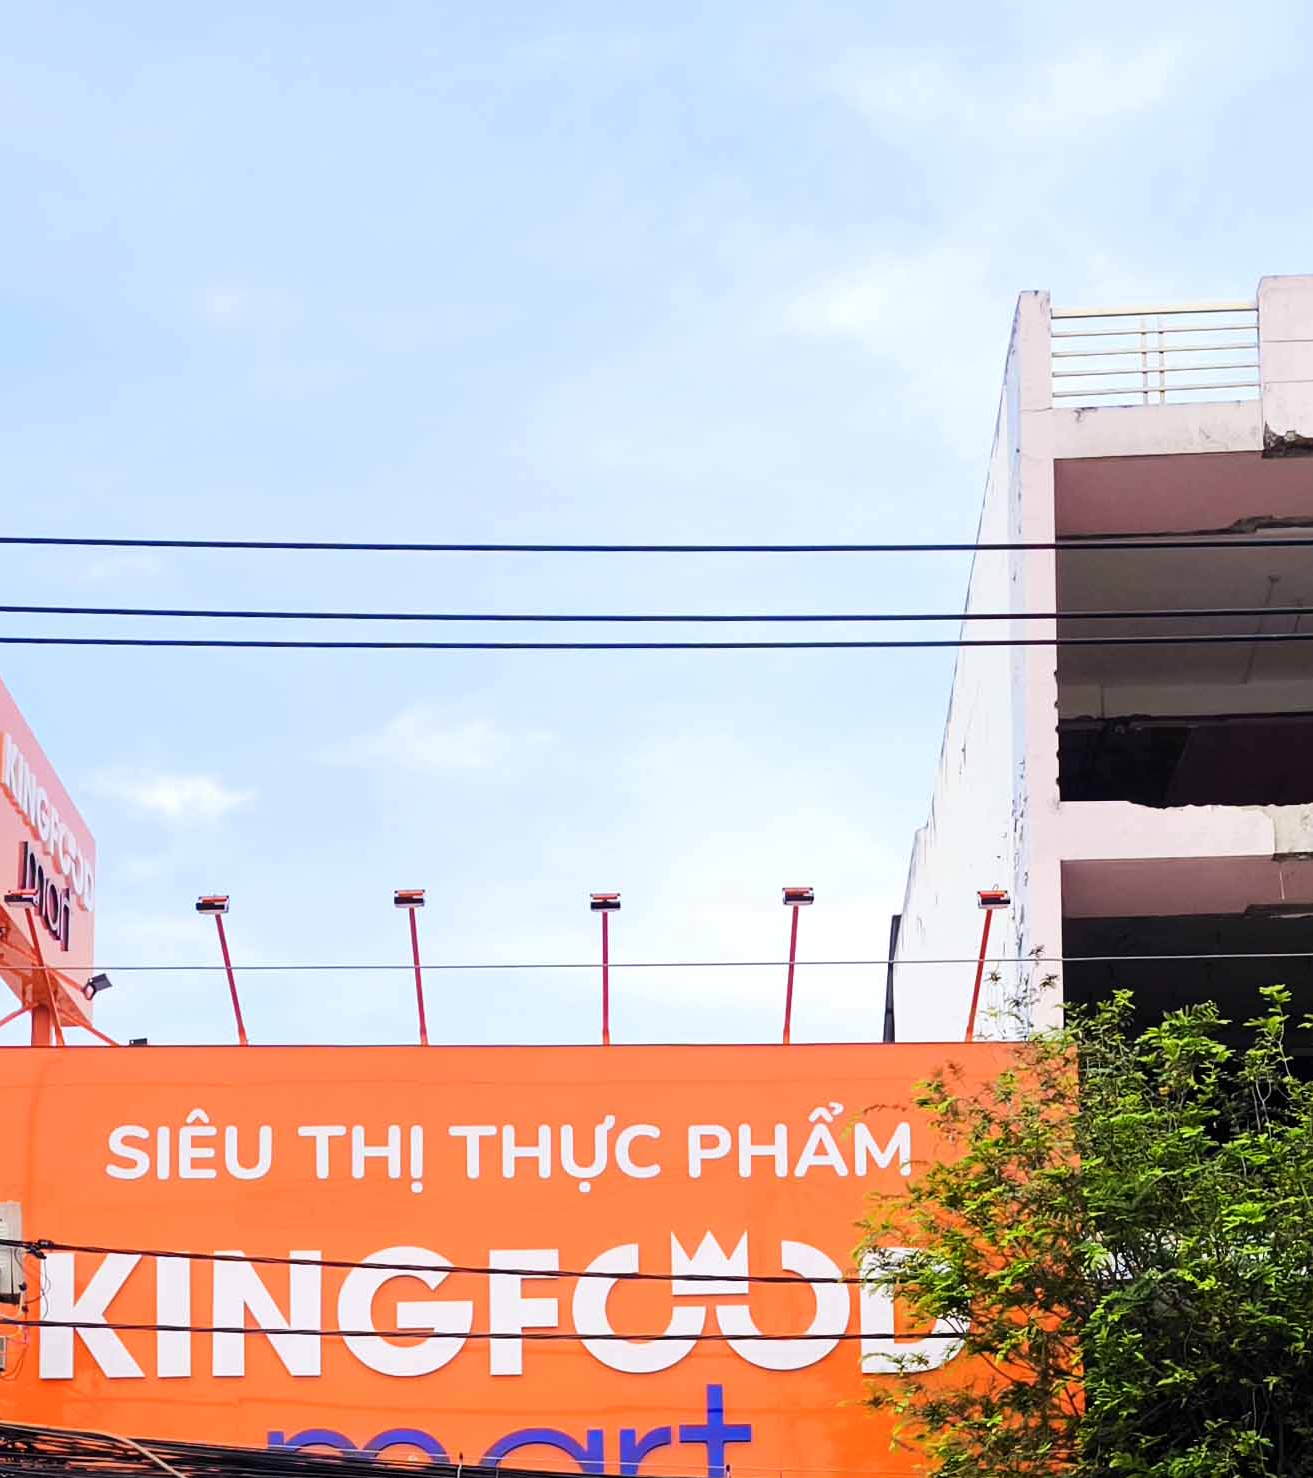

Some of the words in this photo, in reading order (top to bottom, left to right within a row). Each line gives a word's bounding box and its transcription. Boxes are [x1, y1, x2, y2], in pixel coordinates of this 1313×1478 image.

[105, 1108, 273, 1180] SIÊU
[298, 1124, 424, 1193] THỊ
[449, 1114, 662, 1193] THỰC
[688, 1101, 912, 1179] PHẨM
[39, 1231, 972, 1380] KINGFOOD
